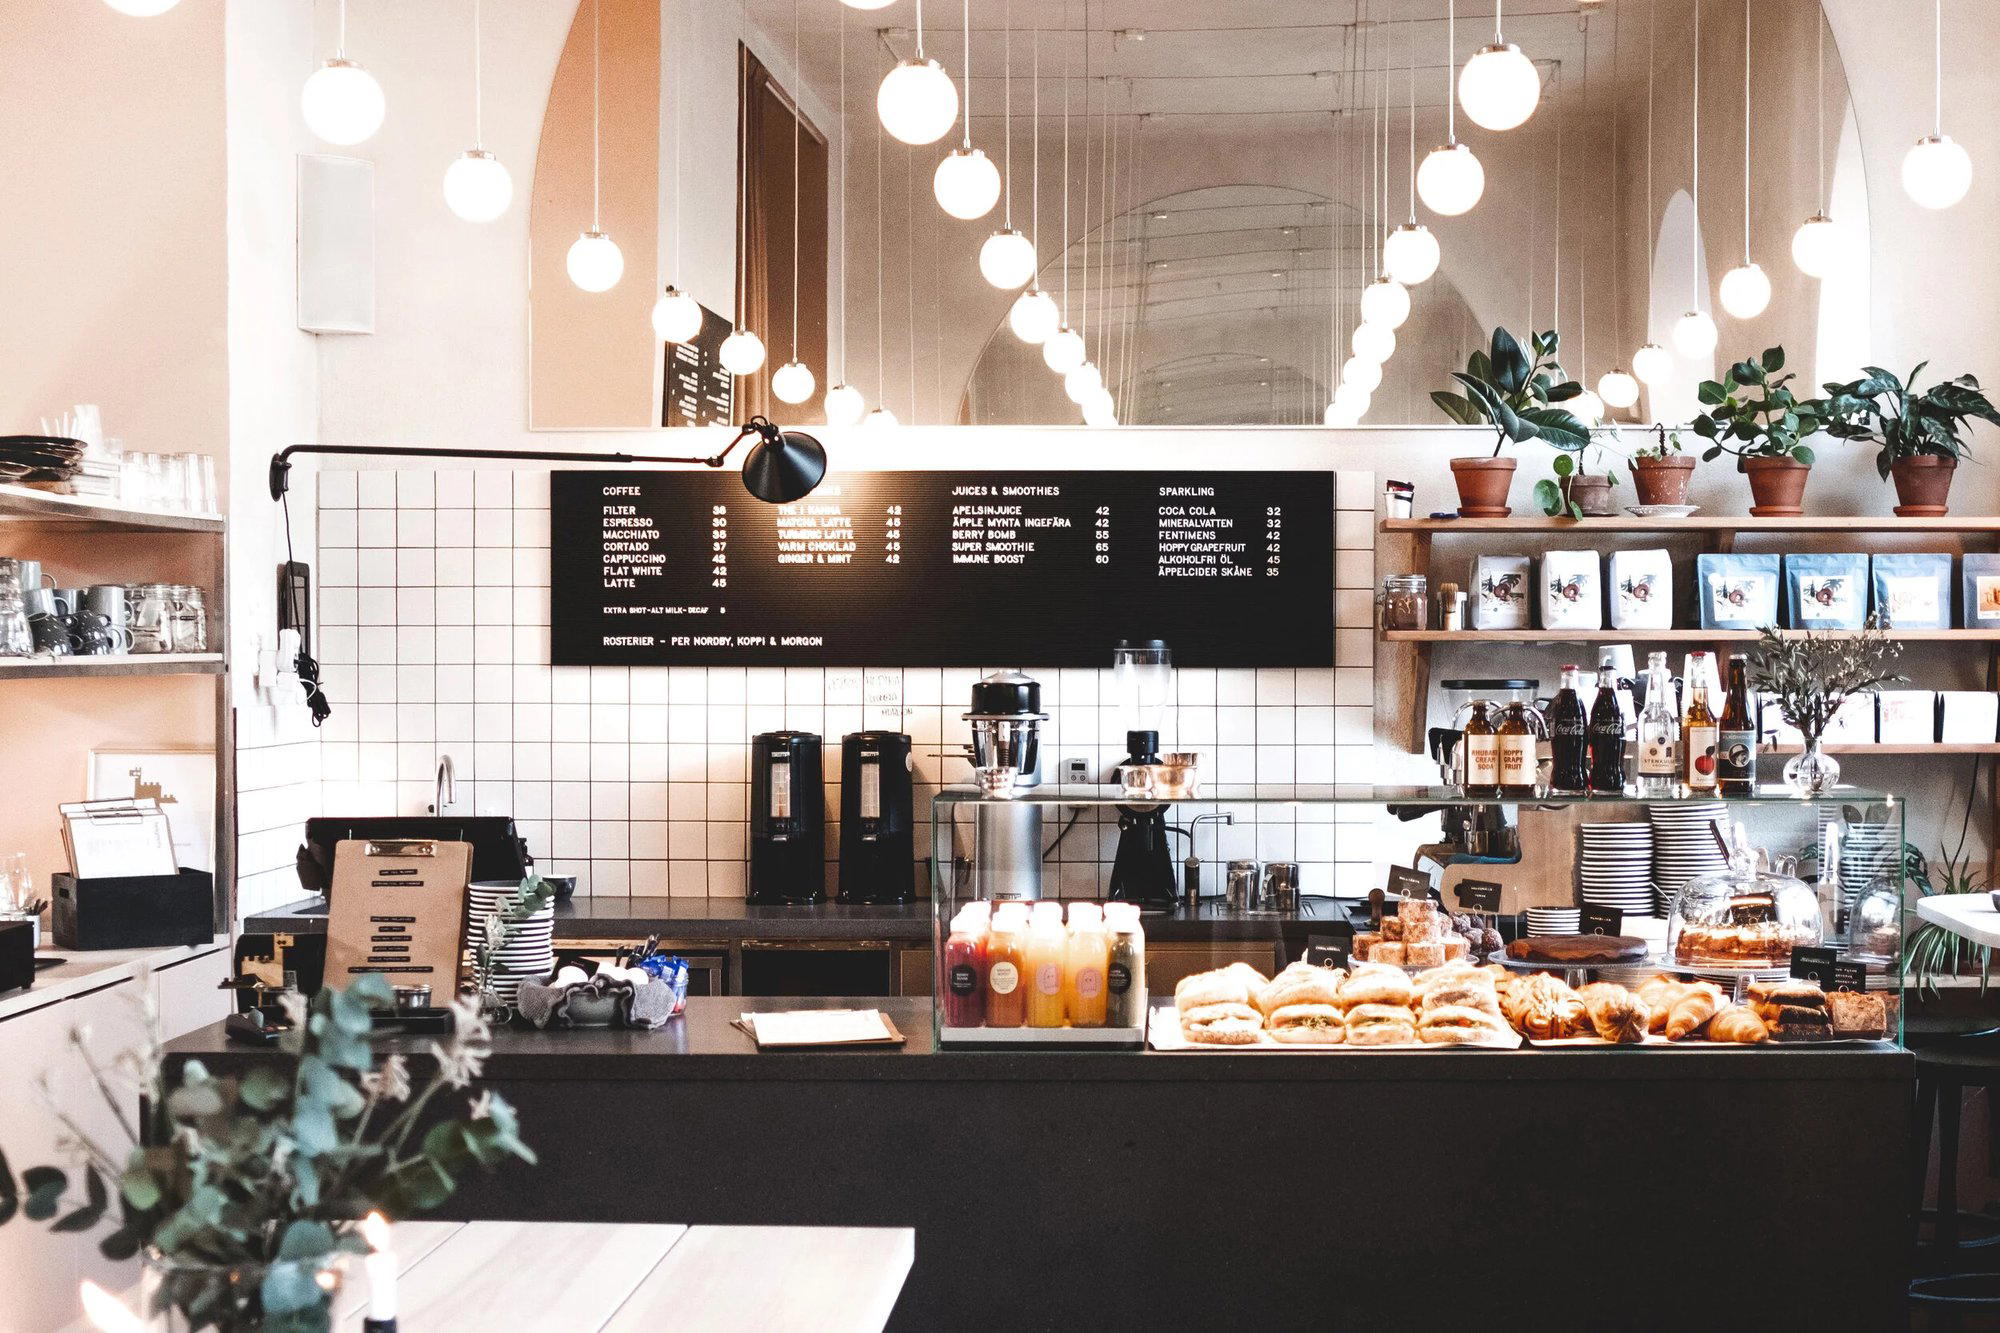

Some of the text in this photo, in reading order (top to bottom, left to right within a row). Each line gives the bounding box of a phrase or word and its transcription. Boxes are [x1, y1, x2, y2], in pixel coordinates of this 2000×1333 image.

[603, 487, 641, 495] COFFEE
[952, 486, 1059, 496] JUICES & SMOOTHIES
[1159, 487, 1214, 496] SPARKLING
[604, 506, 635, 515] FILTER
[887, 506, 901, 515] 42
[953, 506, 1109, 515] APELSINJUICE 42
[1159, 507, 1280, 515] COCA COLA 32
[604, 518, 653, 527] ESPRESSO
[821, 518, 851, 527] LATTE
[988, 518, 1020, 527] MYNTA
[1025, 517, 1071, 527] INGEFÄRA
[1095, 519, 1109, 527] 42
[1159, 519, 1280, 527] MINERALVATTEN 32
[603, 530, 659, 539] MACCHIATO
[825, 530, 853, 539] LATTE
[953, 530, 1109, 539] BERRY BOMB 55
[1159, 531, 1216, 540] FENTIMENS
[604, 542, 726, 551] CORTADO 37
[778, 542, 805, 551] VARM
[808, 542, 856, 551] CHOKLAD
[952, 542, 1108, 551] SUPER SMOOTHIE 65
[1159, 543, 1280, 552] HOPPY GRAPEFRUIT 42
[603, 554, 726, 563] CAPPUCCINO 42
[778, 554, 899, 563] GINGER & MINT 42
[953, 554, 1109, 563] IMMUNE BOOST 60
[1159, 554, 1280, 564] ALKOHOLFRI ÖL 45
[604, 566, 727, 575] FLAT WHITE 42
[1159, 566, 1278, 576] ÄPPELCIDER SKÅNE 35
[604, 579, 726, 587] LATTE 45
[604, 637, 653, 645] ROSTERIER
[672, 637, 690, 645] PER
[694, 637, 733, 647] NORDBY,
[737, 637, 765, 646] KOPPI
[770, 637, 776, 645] &
[782, 637, 822, 646] MORGON
